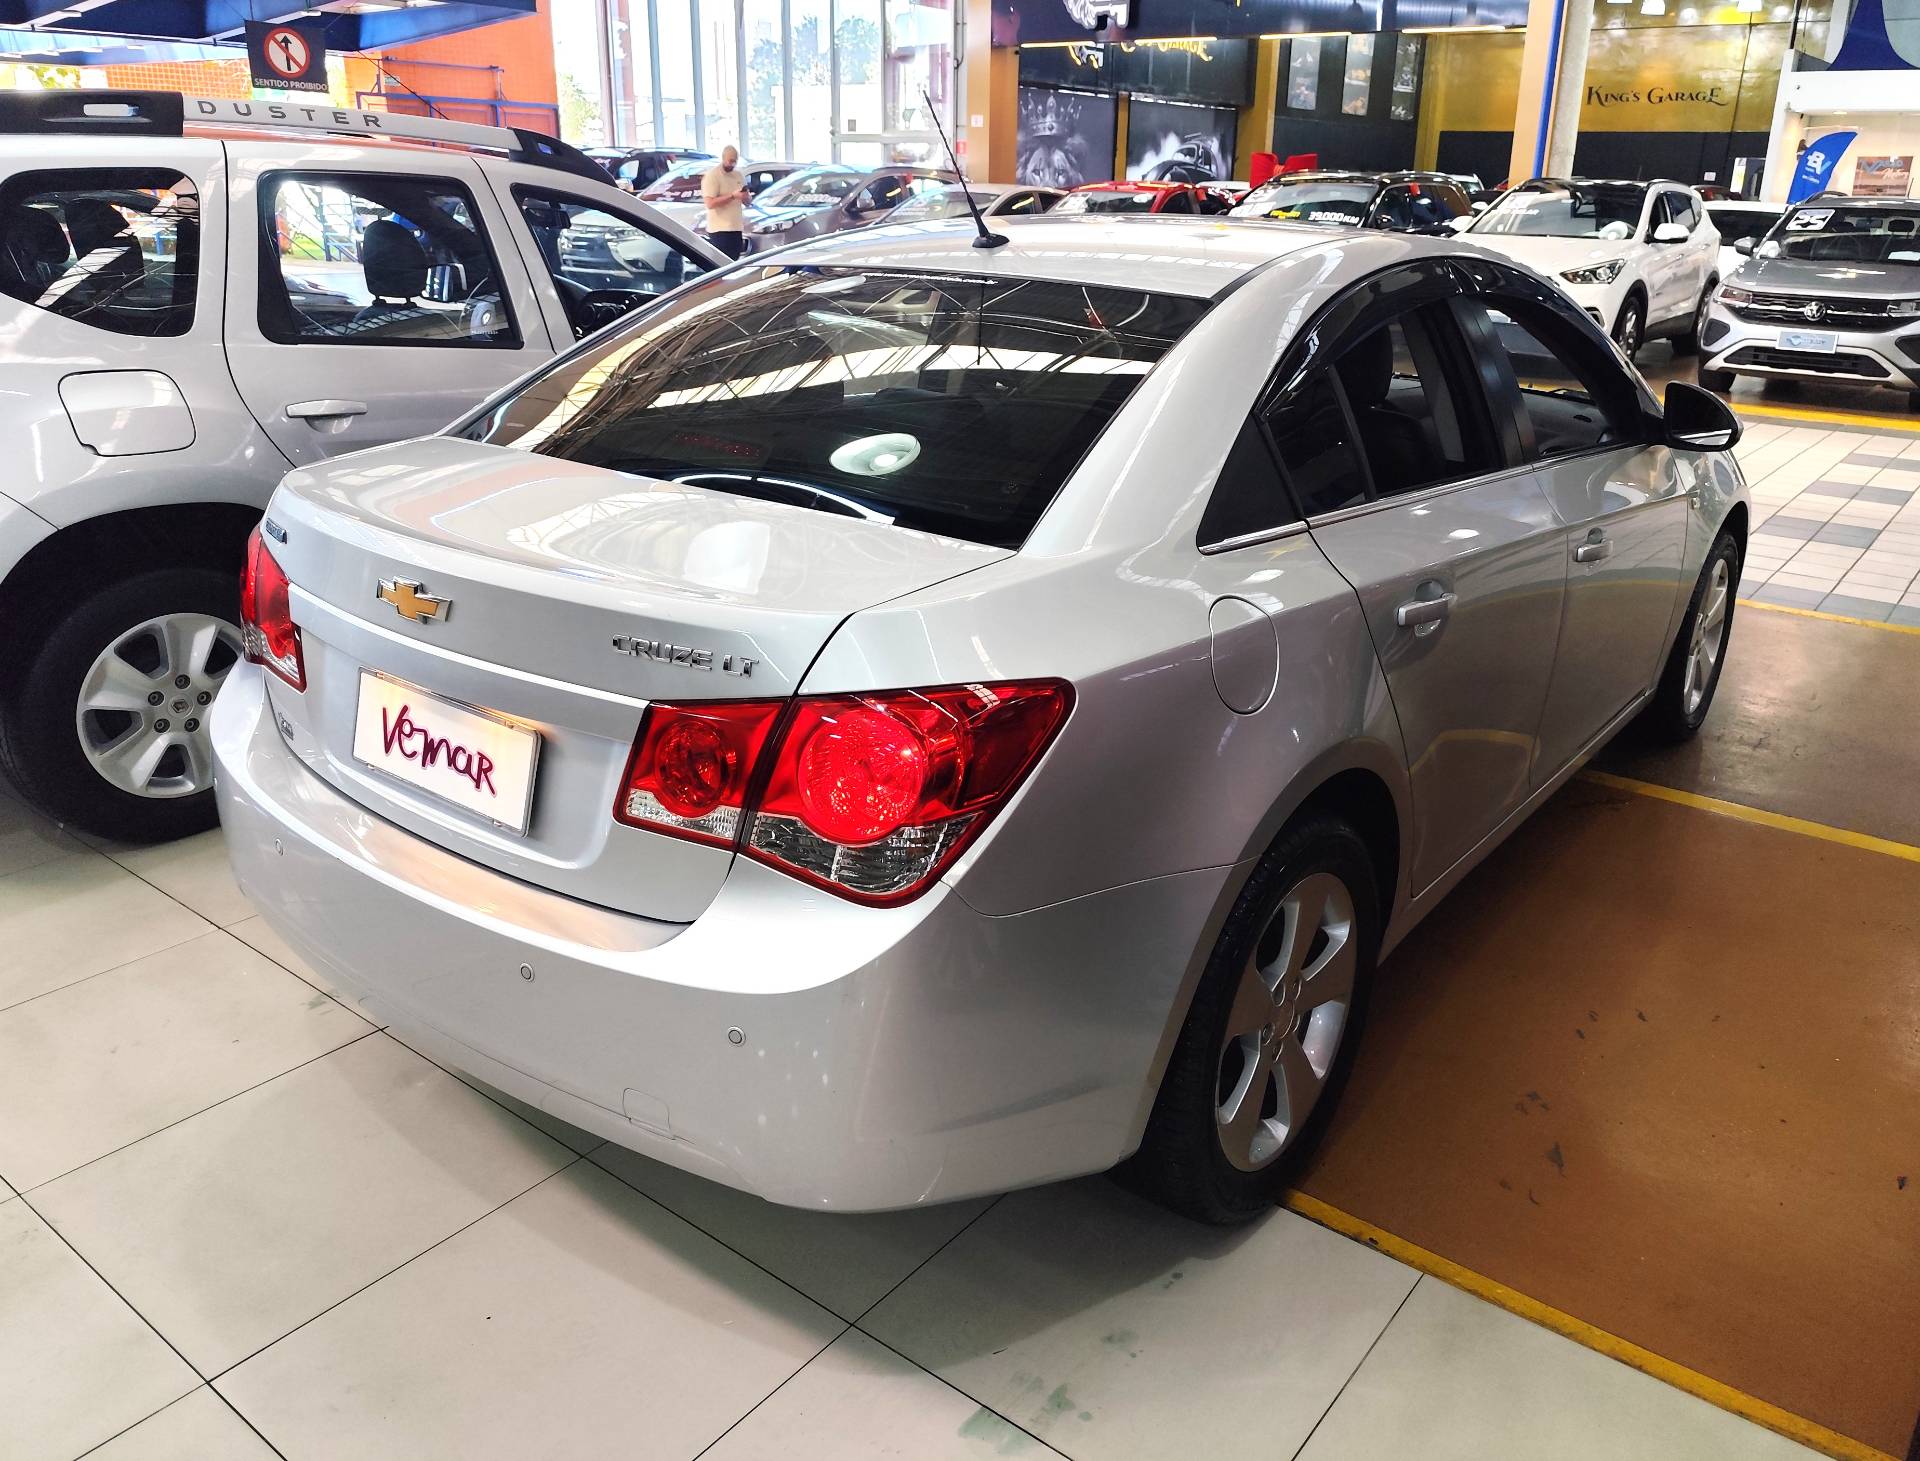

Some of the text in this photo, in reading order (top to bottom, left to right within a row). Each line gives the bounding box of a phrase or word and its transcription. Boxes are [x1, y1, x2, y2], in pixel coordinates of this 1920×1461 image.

[254, 77, 329, 92] SENTIDO PROIBIDO
[1647, 86, 1729, 107] GARAGE
[197, 100, 382, 128] DUSTER
[612, 633, 760, 678] CRUZE LT
